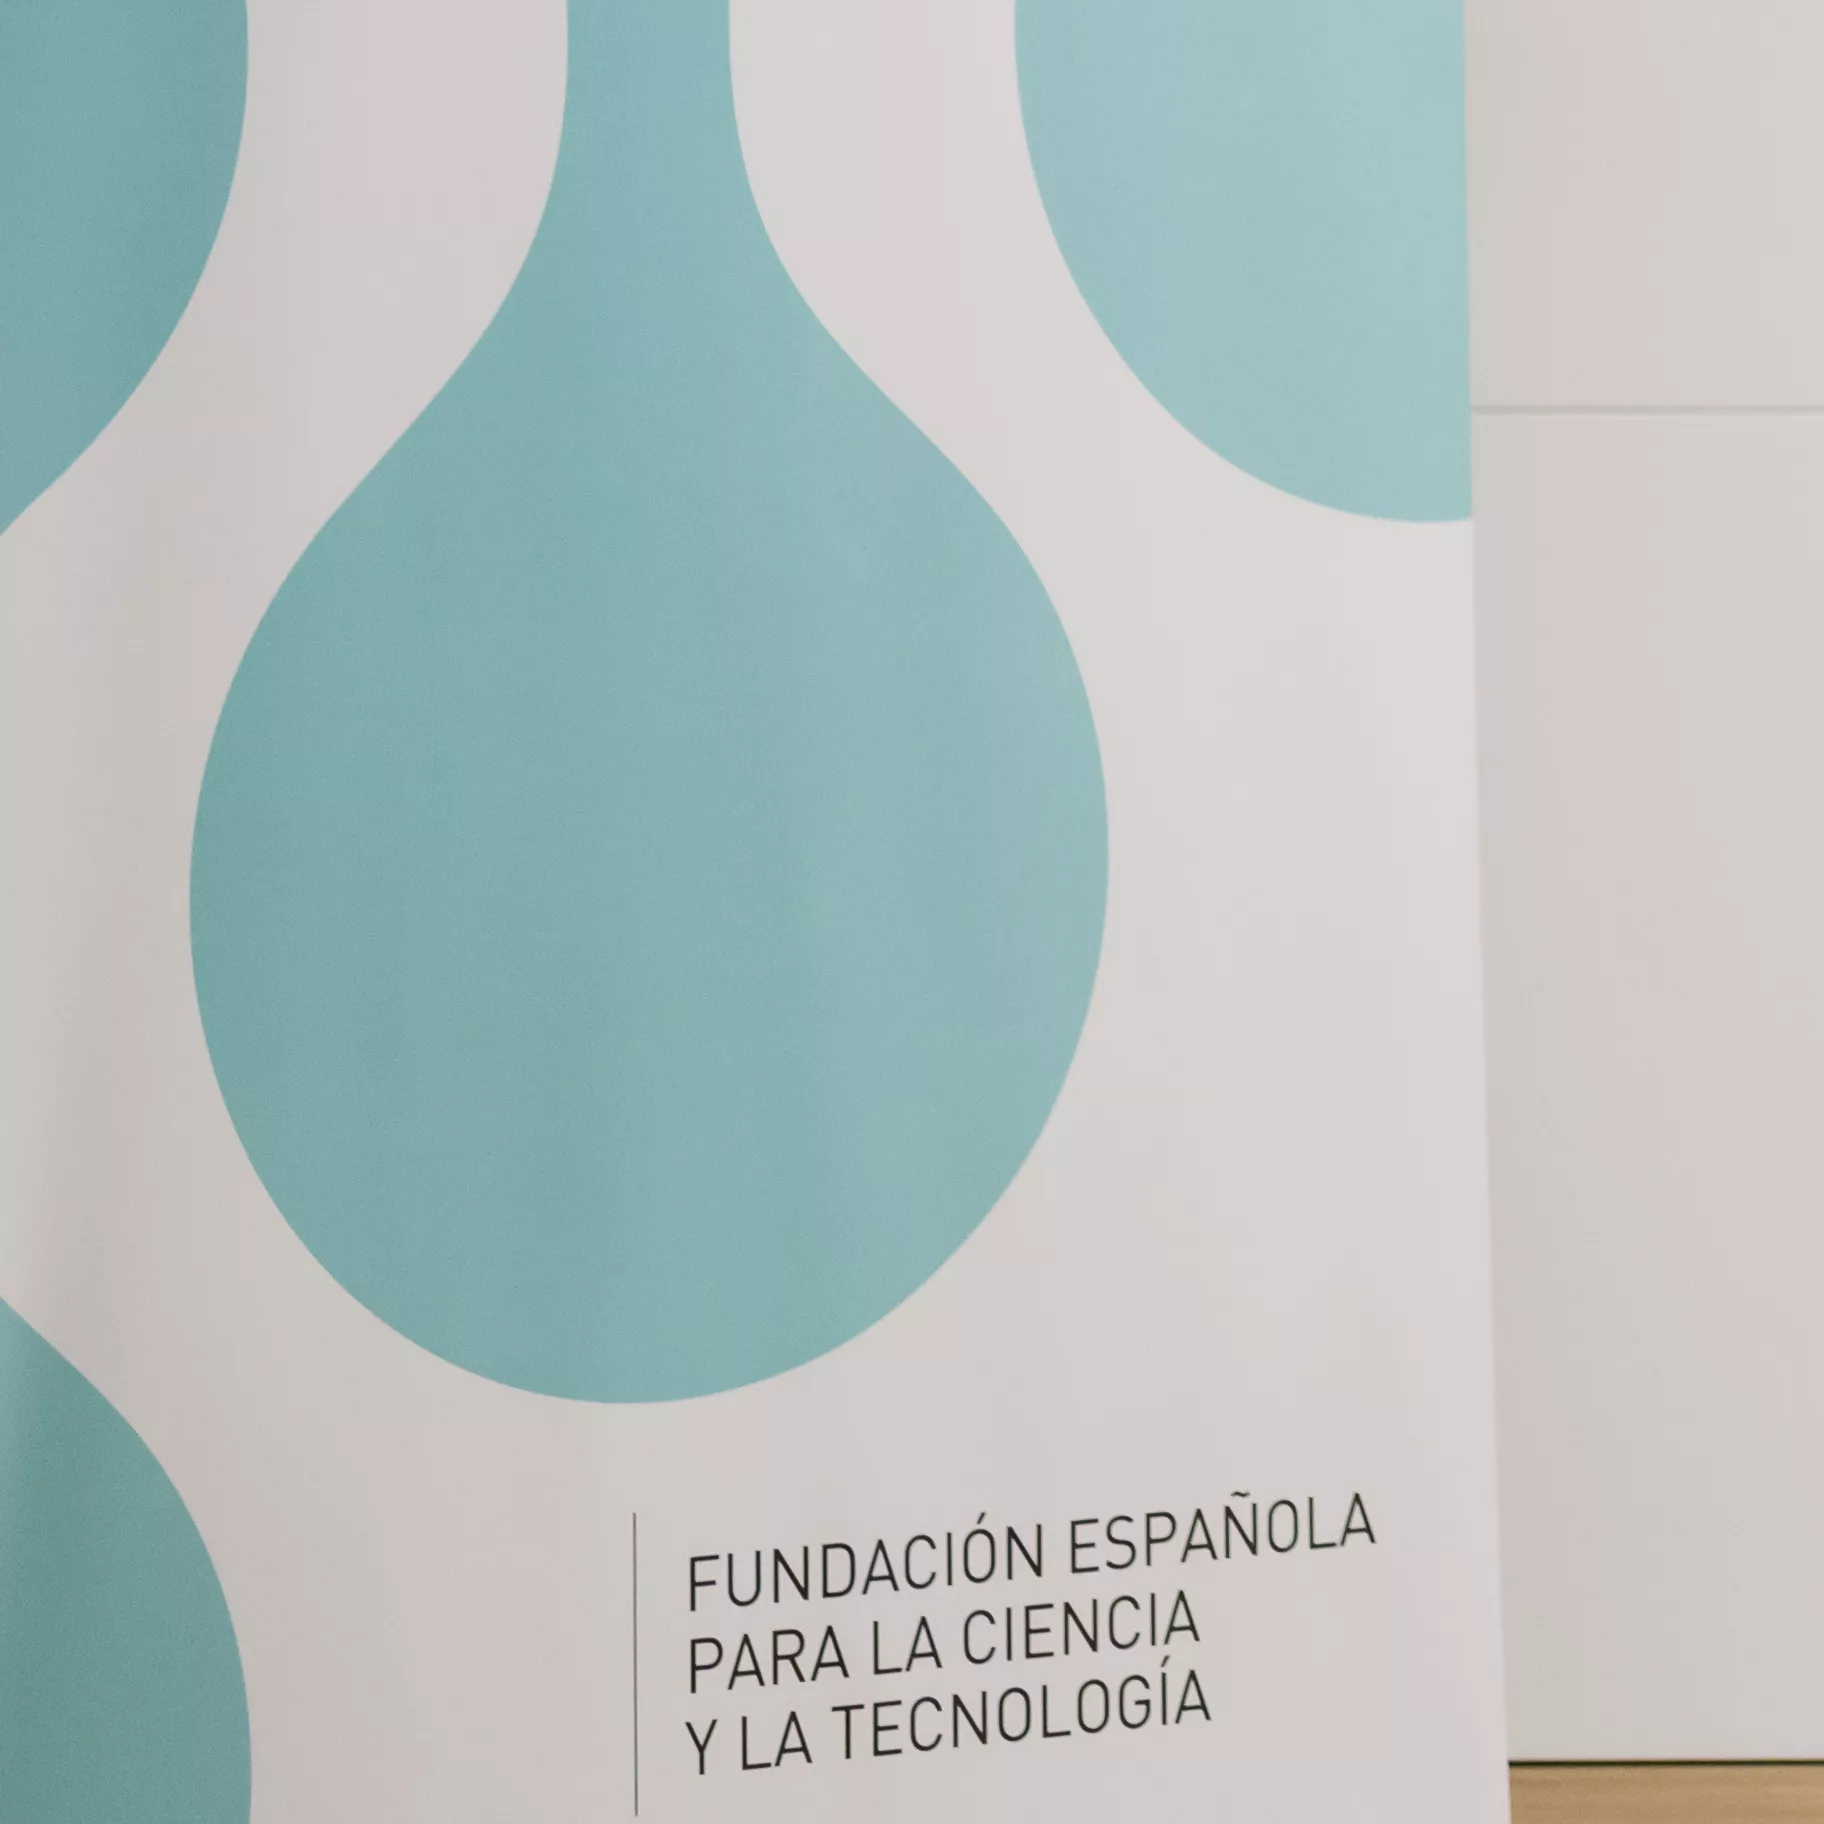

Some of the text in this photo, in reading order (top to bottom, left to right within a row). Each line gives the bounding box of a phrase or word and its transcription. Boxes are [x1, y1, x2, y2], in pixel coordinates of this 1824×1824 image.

[689, 1490, 1377, 1612] FUNDACIÓN ESPAÑOLA
[689, 1589, 1201, 1694] PARA LA CIENCIA
[685, 1655, 1212, 1776] Y LA TECNOLOGÍA
